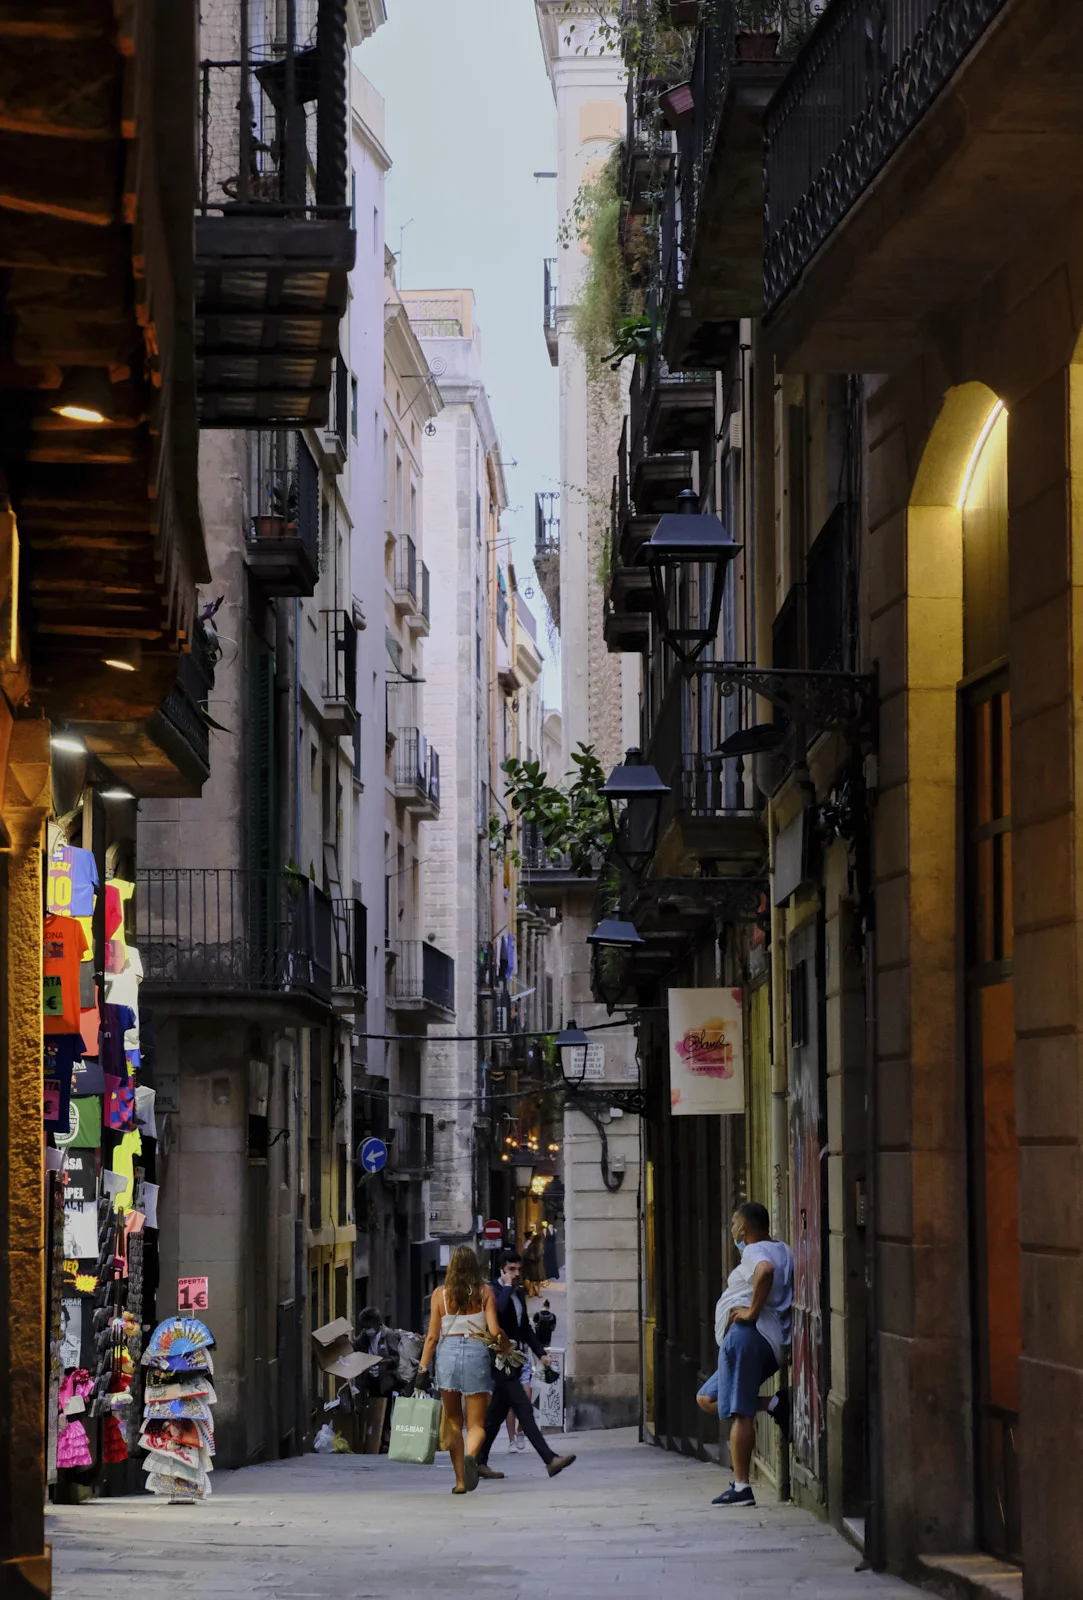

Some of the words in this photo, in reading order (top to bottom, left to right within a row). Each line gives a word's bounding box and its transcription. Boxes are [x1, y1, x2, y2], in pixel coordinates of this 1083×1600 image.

[47, 875, 72, 907] 10
[63, 1157, 83, 1170] ASA
[64, 1187, 85, 1200] APEL
